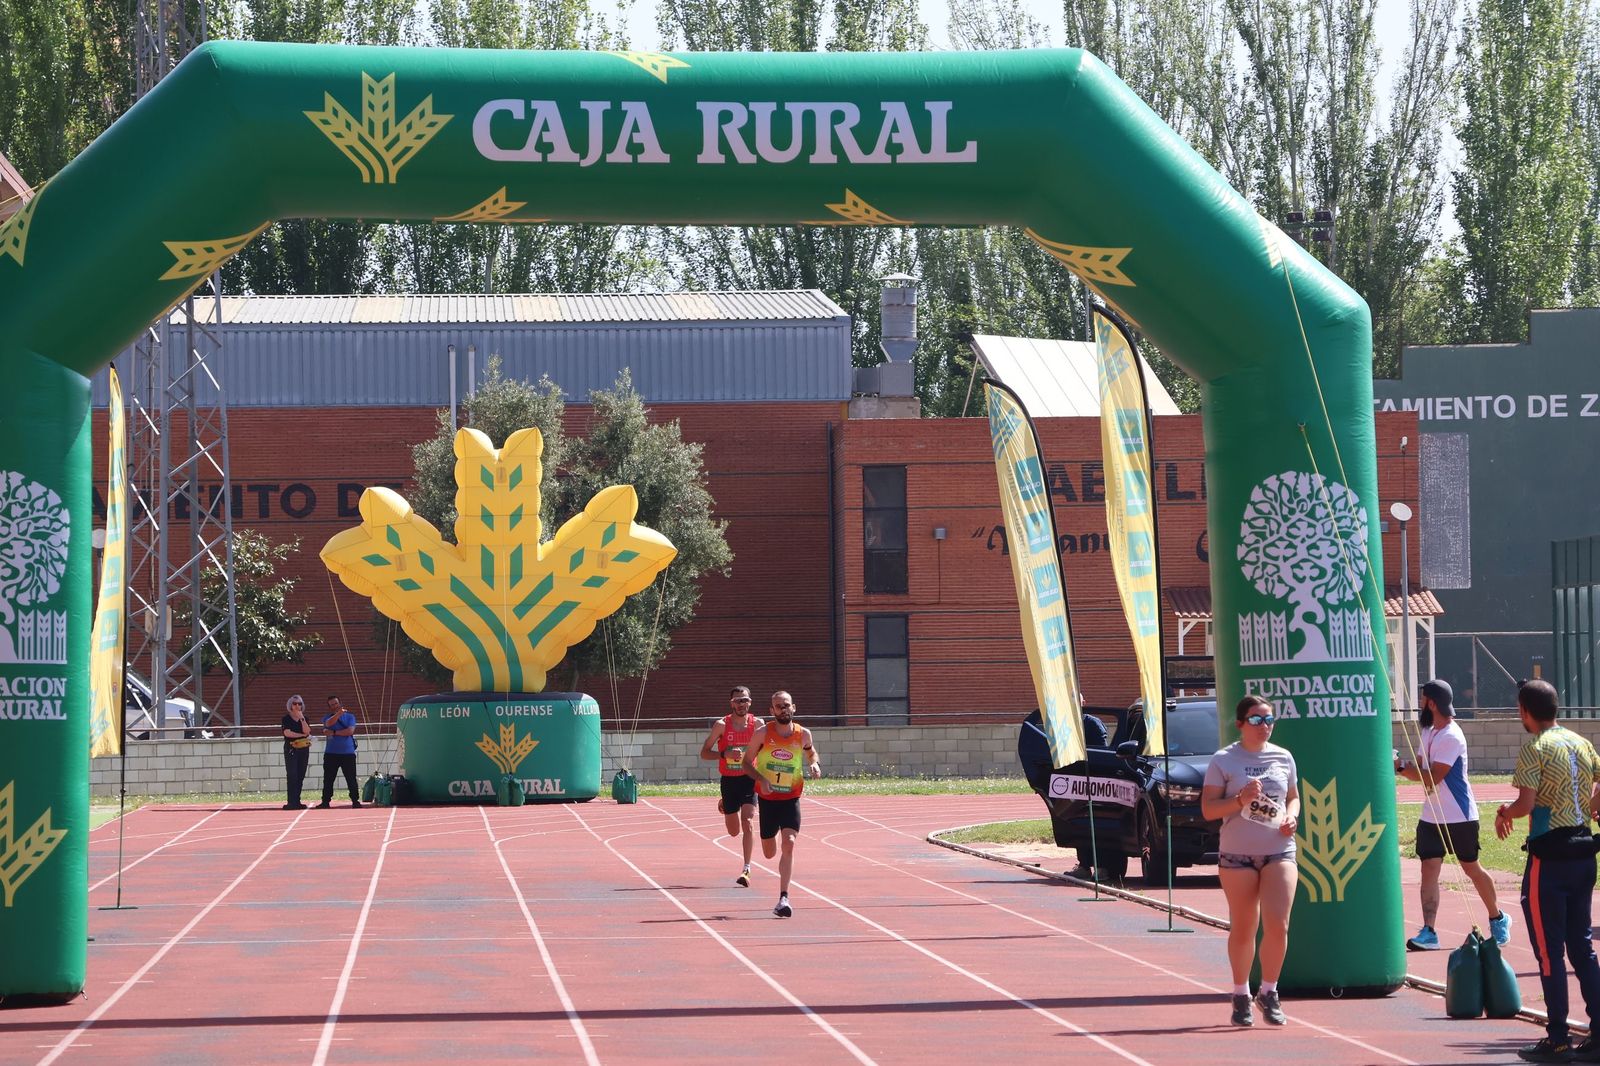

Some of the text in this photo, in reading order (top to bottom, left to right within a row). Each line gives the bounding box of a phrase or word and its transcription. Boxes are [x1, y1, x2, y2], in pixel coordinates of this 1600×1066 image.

[472, 98, 978, 168] CAJA RURAL
[1373, 393, 1600, 421] AMIENTO DE Z
[1243, 674, 1376, 699] FUNDACION
[440, 705, 470, 719] LEÓN
[495, 705, 553, 717] OURENSE
[1306, 696, 1378, 719] RURAL
[775, 772, 781, 784] 1
[448, 780, 496, 797] CAJA
[1250, 800, 1278, 818] 948
